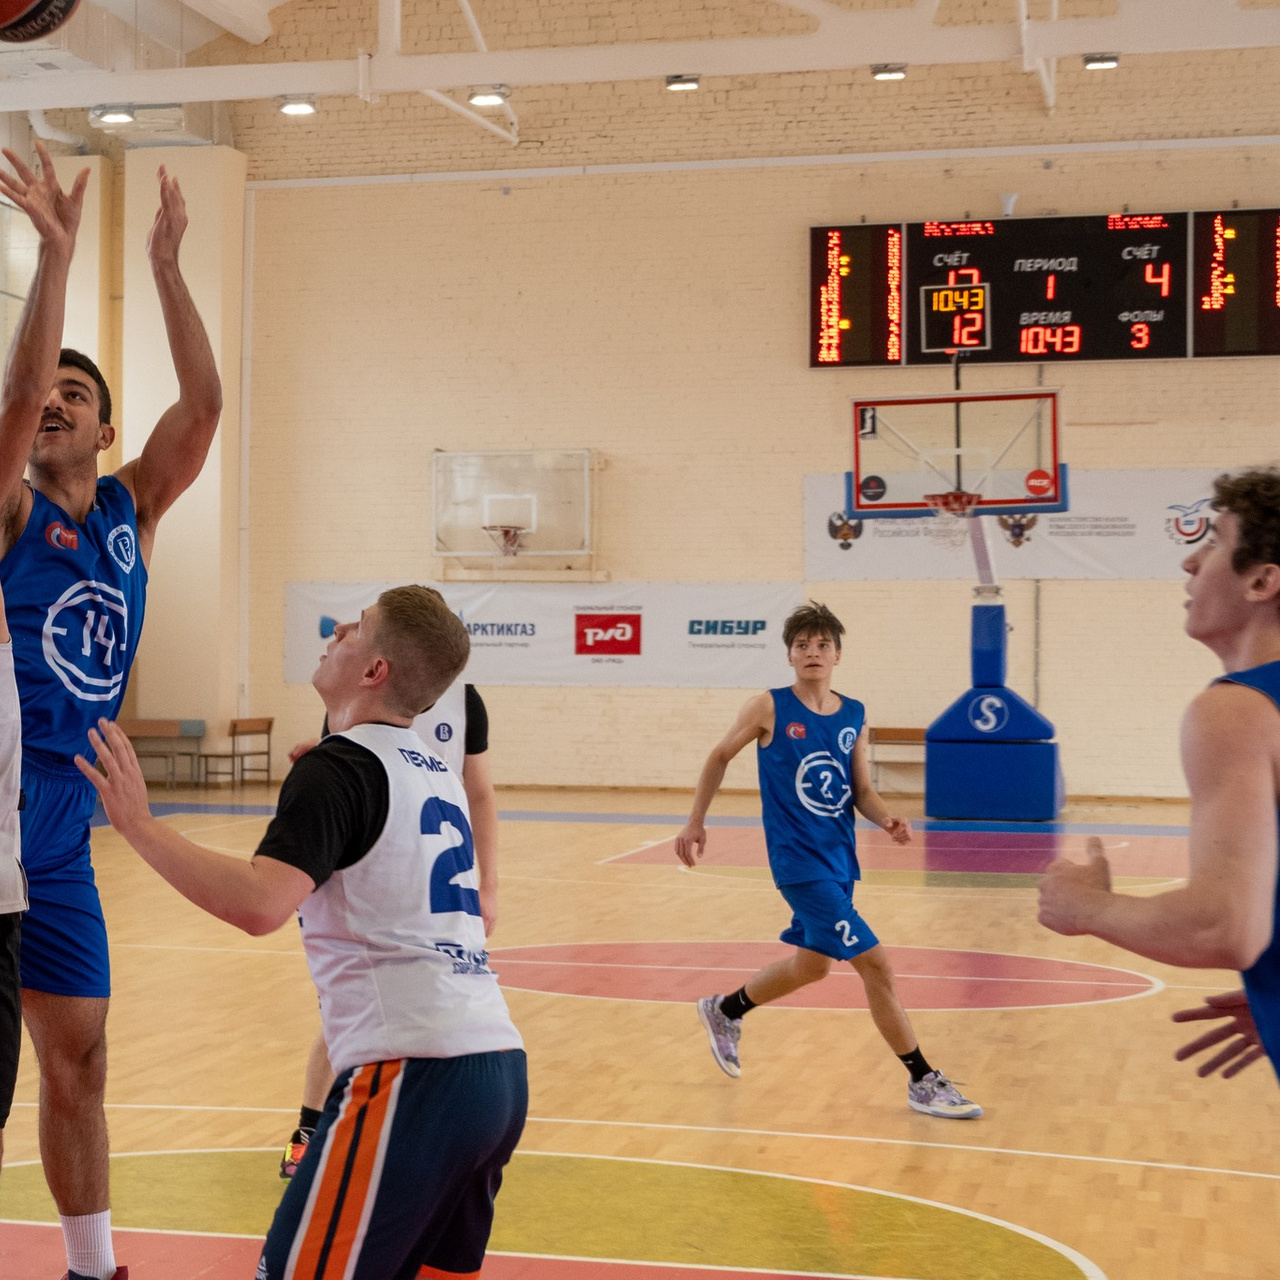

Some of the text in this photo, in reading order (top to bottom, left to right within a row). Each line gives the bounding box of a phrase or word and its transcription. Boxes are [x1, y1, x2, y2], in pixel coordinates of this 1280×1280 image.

[933, 251, 970, 266] СЧЁТ
[1013, 257, 1078, 272] ПЕРИОД
[1121, 245, 1161, 260] СЧЁТ
[1046, 274, 1056, 300] 1
[1144, 263, 1171, 297] 4
[1020, 311, 1072, 325] ВРЕМЯ
[1118, 310, 1164, 322] ФОЛЫ
[953, 313, 982, 345] 12
[1131, 323, 1149, 348] 3
[81, 610, 116, 666] 14
[466, 622, 536, 637] АРКТИКГАЗ
[688, 620, 767, 636] СИБУР
[820, 771, 833, 798] 2
[420, 796, 482, 917] 2
[835, 919, 859, 947] 2
